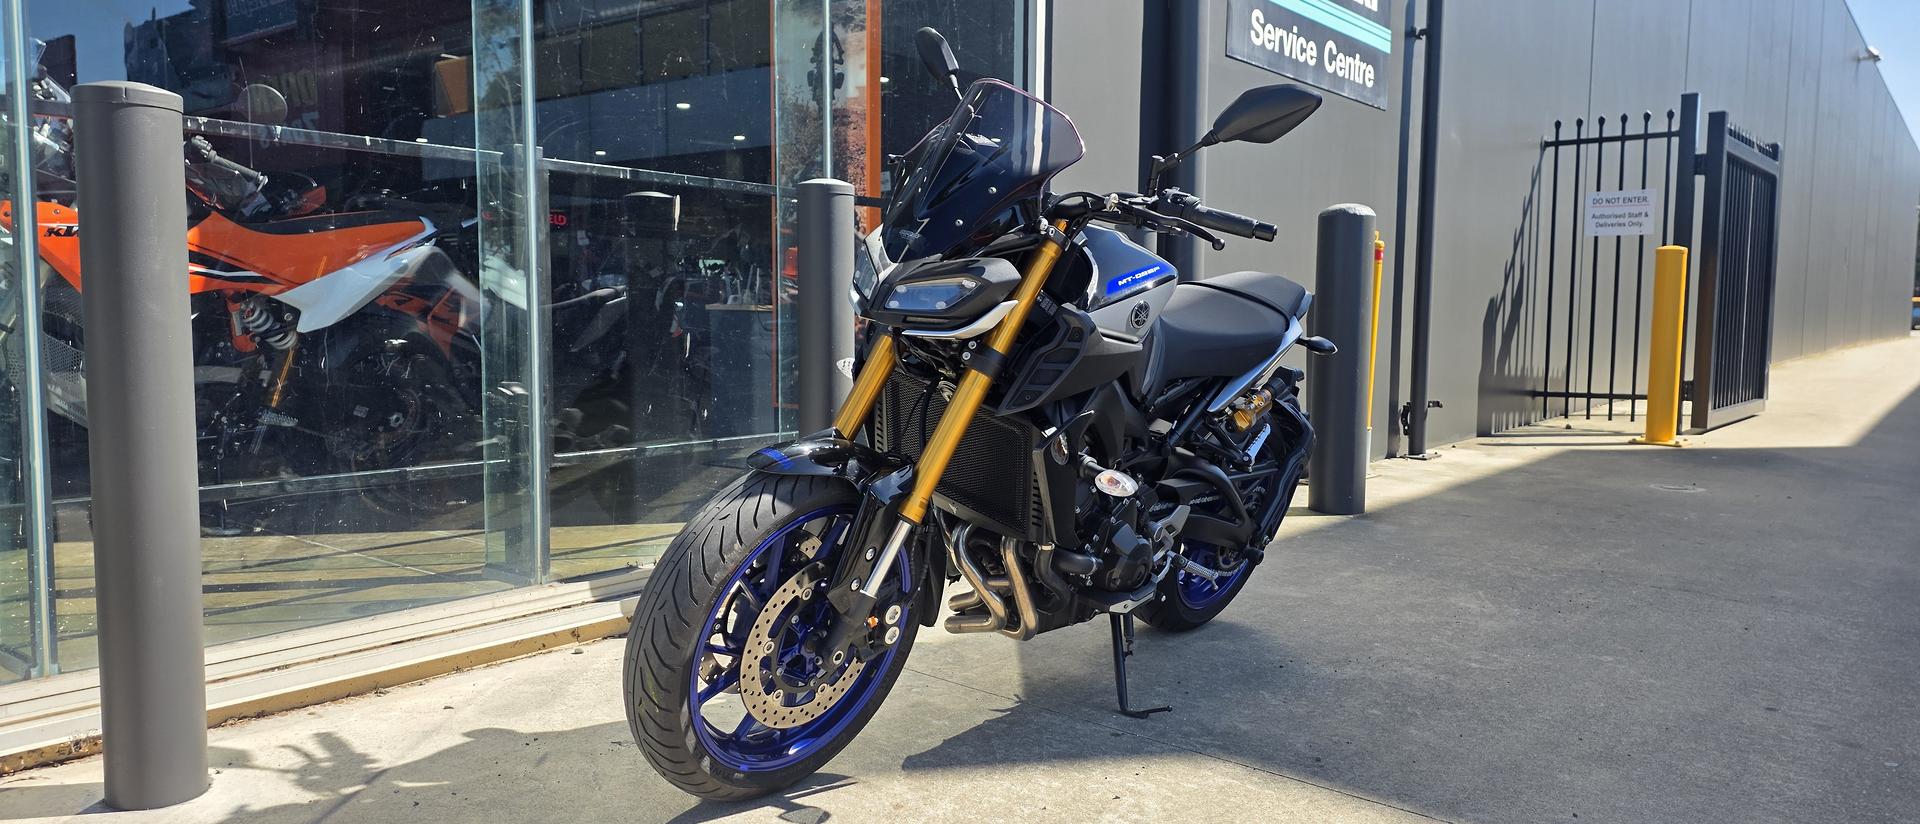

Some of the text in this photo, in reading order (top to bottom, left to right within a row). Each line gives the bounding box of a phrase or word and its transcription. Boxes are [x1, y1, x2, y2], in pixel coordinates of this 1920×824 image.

[1250, 8, 1375, 88] Service Centre
[1592, 197, 1604, 205] DO
[1605, 196, 1620, 204] NOT
[1644, 210, 1649, 218] &
[43, 225, 79, 237] KT
